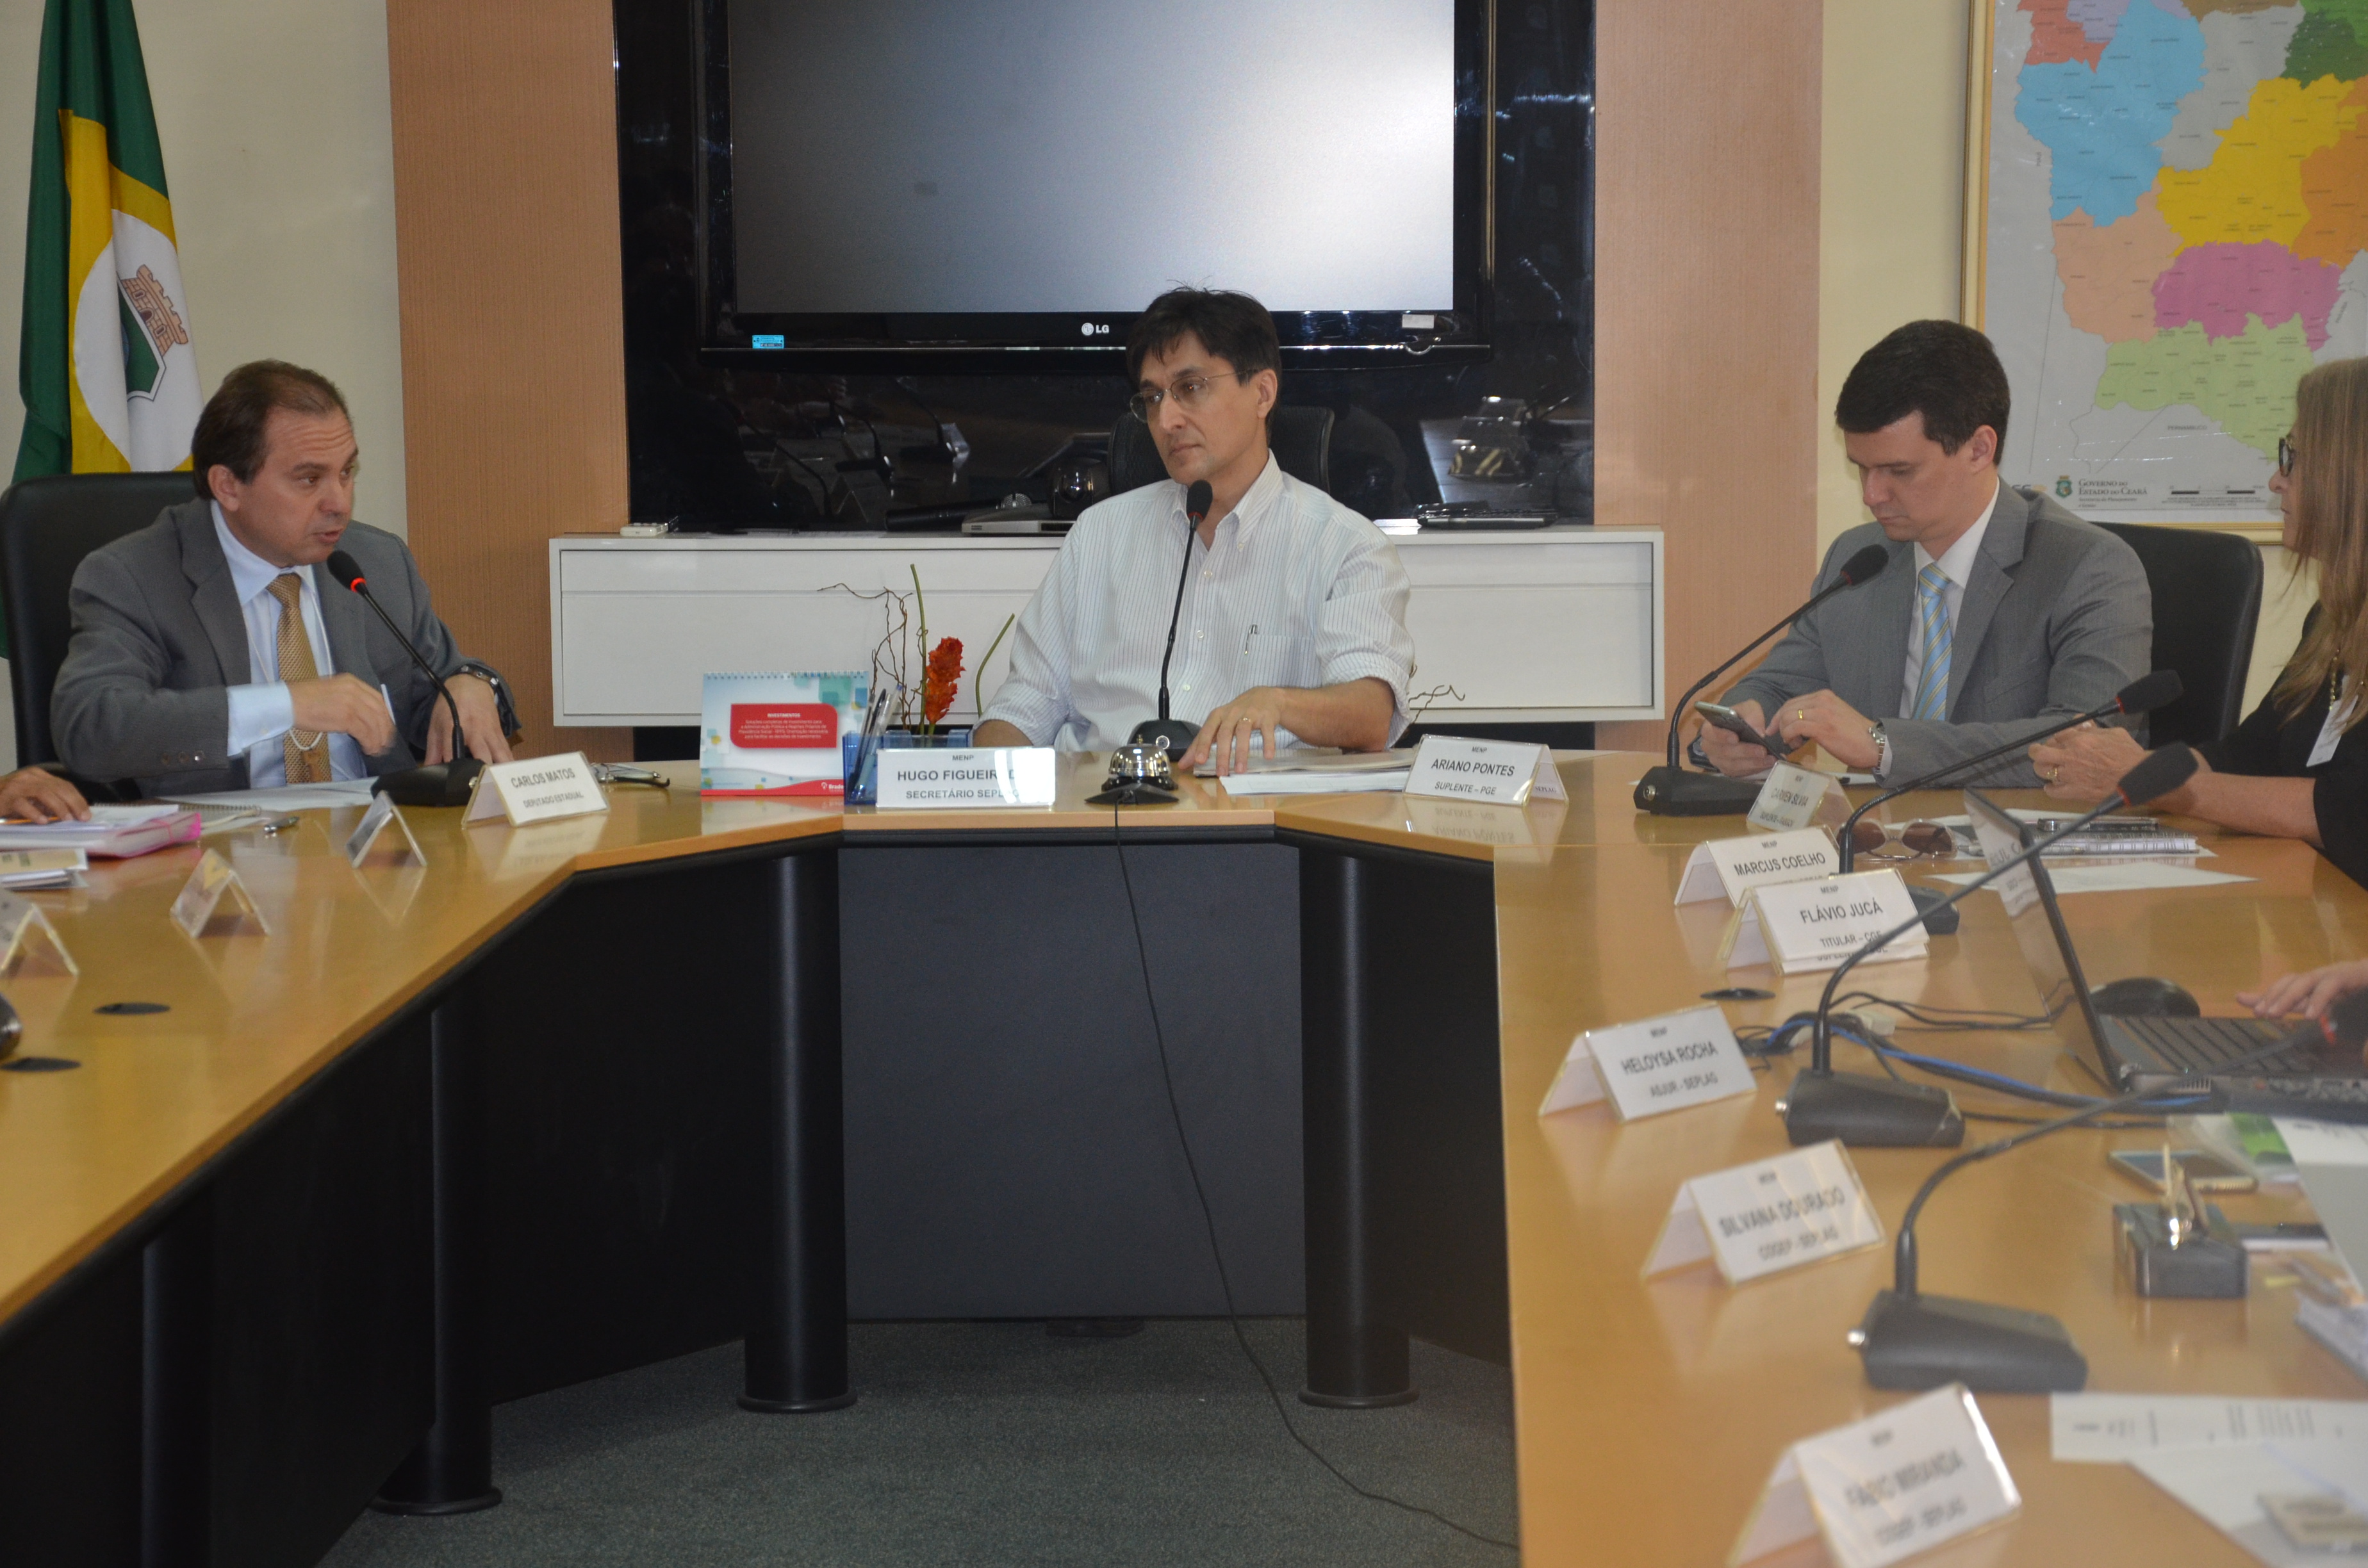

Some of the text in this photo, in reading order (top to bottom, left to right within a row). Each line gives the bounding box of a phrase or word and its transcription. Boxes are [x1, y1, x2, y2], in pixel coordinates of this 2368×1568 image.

[1096, 324, 1109, 333] LG
[898, 771, 939, 781] HUGO
[1431, 758, 1515, 776] ARIANO PONTES
[511, 767, 575, 788] CARLOS MATOS
[906, 788, 1019, 799] SECRETÁRIO SEPLG
[1435, 781, 1474, 793] SUPLENTE
[1480, 785, 1497, 795] PGE
[523, 790, 584, 808] DEPUTADO ESTADUAL
[1762, 840, 1777, 849] MENP
[1734, 852, 1826, 876] MARCUS COELHO
[1820, 885, 1839, 894] MENP
[1800, 897, 1883, 923] FLÁVIO JUCÁ
[1820, 934, 1857, 947] TITULAR
[1621, 1041, 1718, 1075] HELOYSA ROCHA
[1683, 1071, 1718, 1090] SEPLAG
[1719, 1205, 1781, 1237] SILVANA
